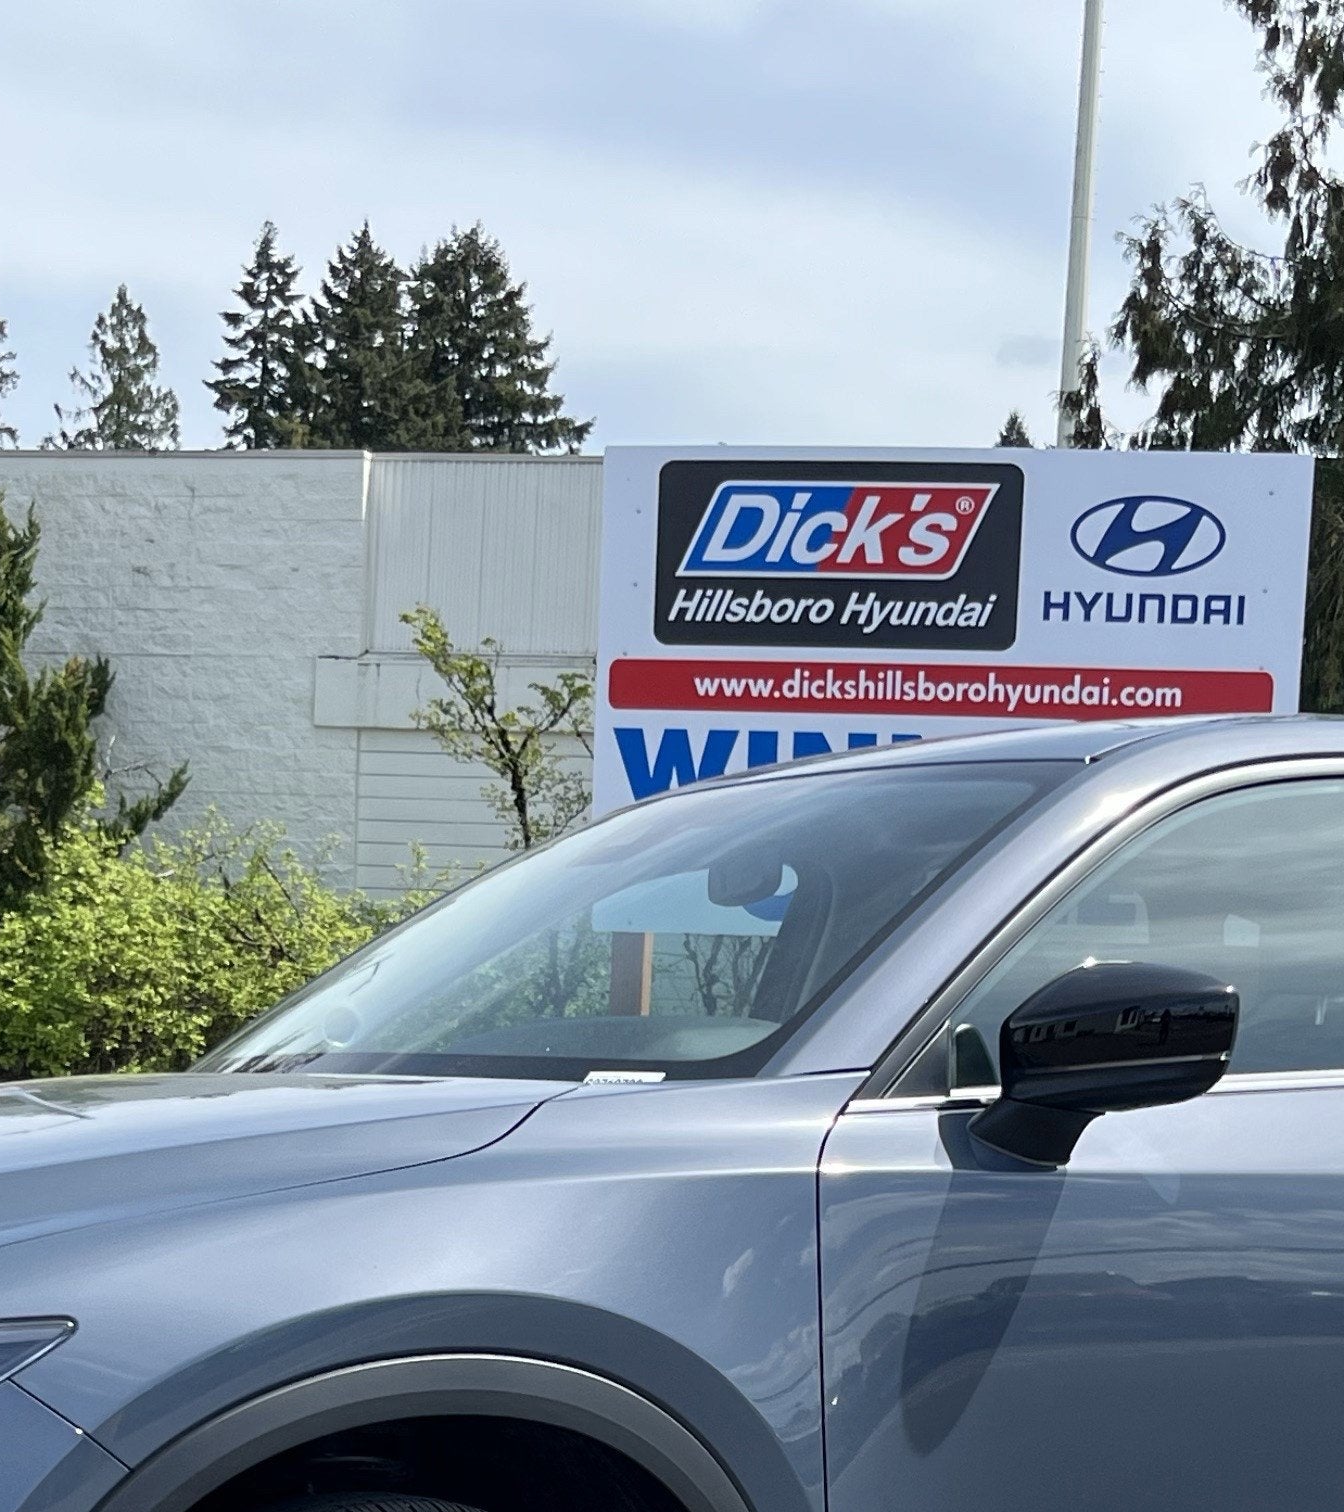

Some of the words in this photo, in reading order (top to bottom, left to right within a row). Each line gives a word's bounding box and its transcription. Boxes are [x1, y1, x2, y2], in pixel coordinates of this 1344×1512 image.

[702, 492, 958, 567] Dick's
[667, 588, 835, 625] Hillsboro
[840, 591, 999, 635] Hyundai
[1043, 591, 1247, 626] HYUNDAI
[694, 669, 1183, 712] www.dickshillsborohyundai.com
